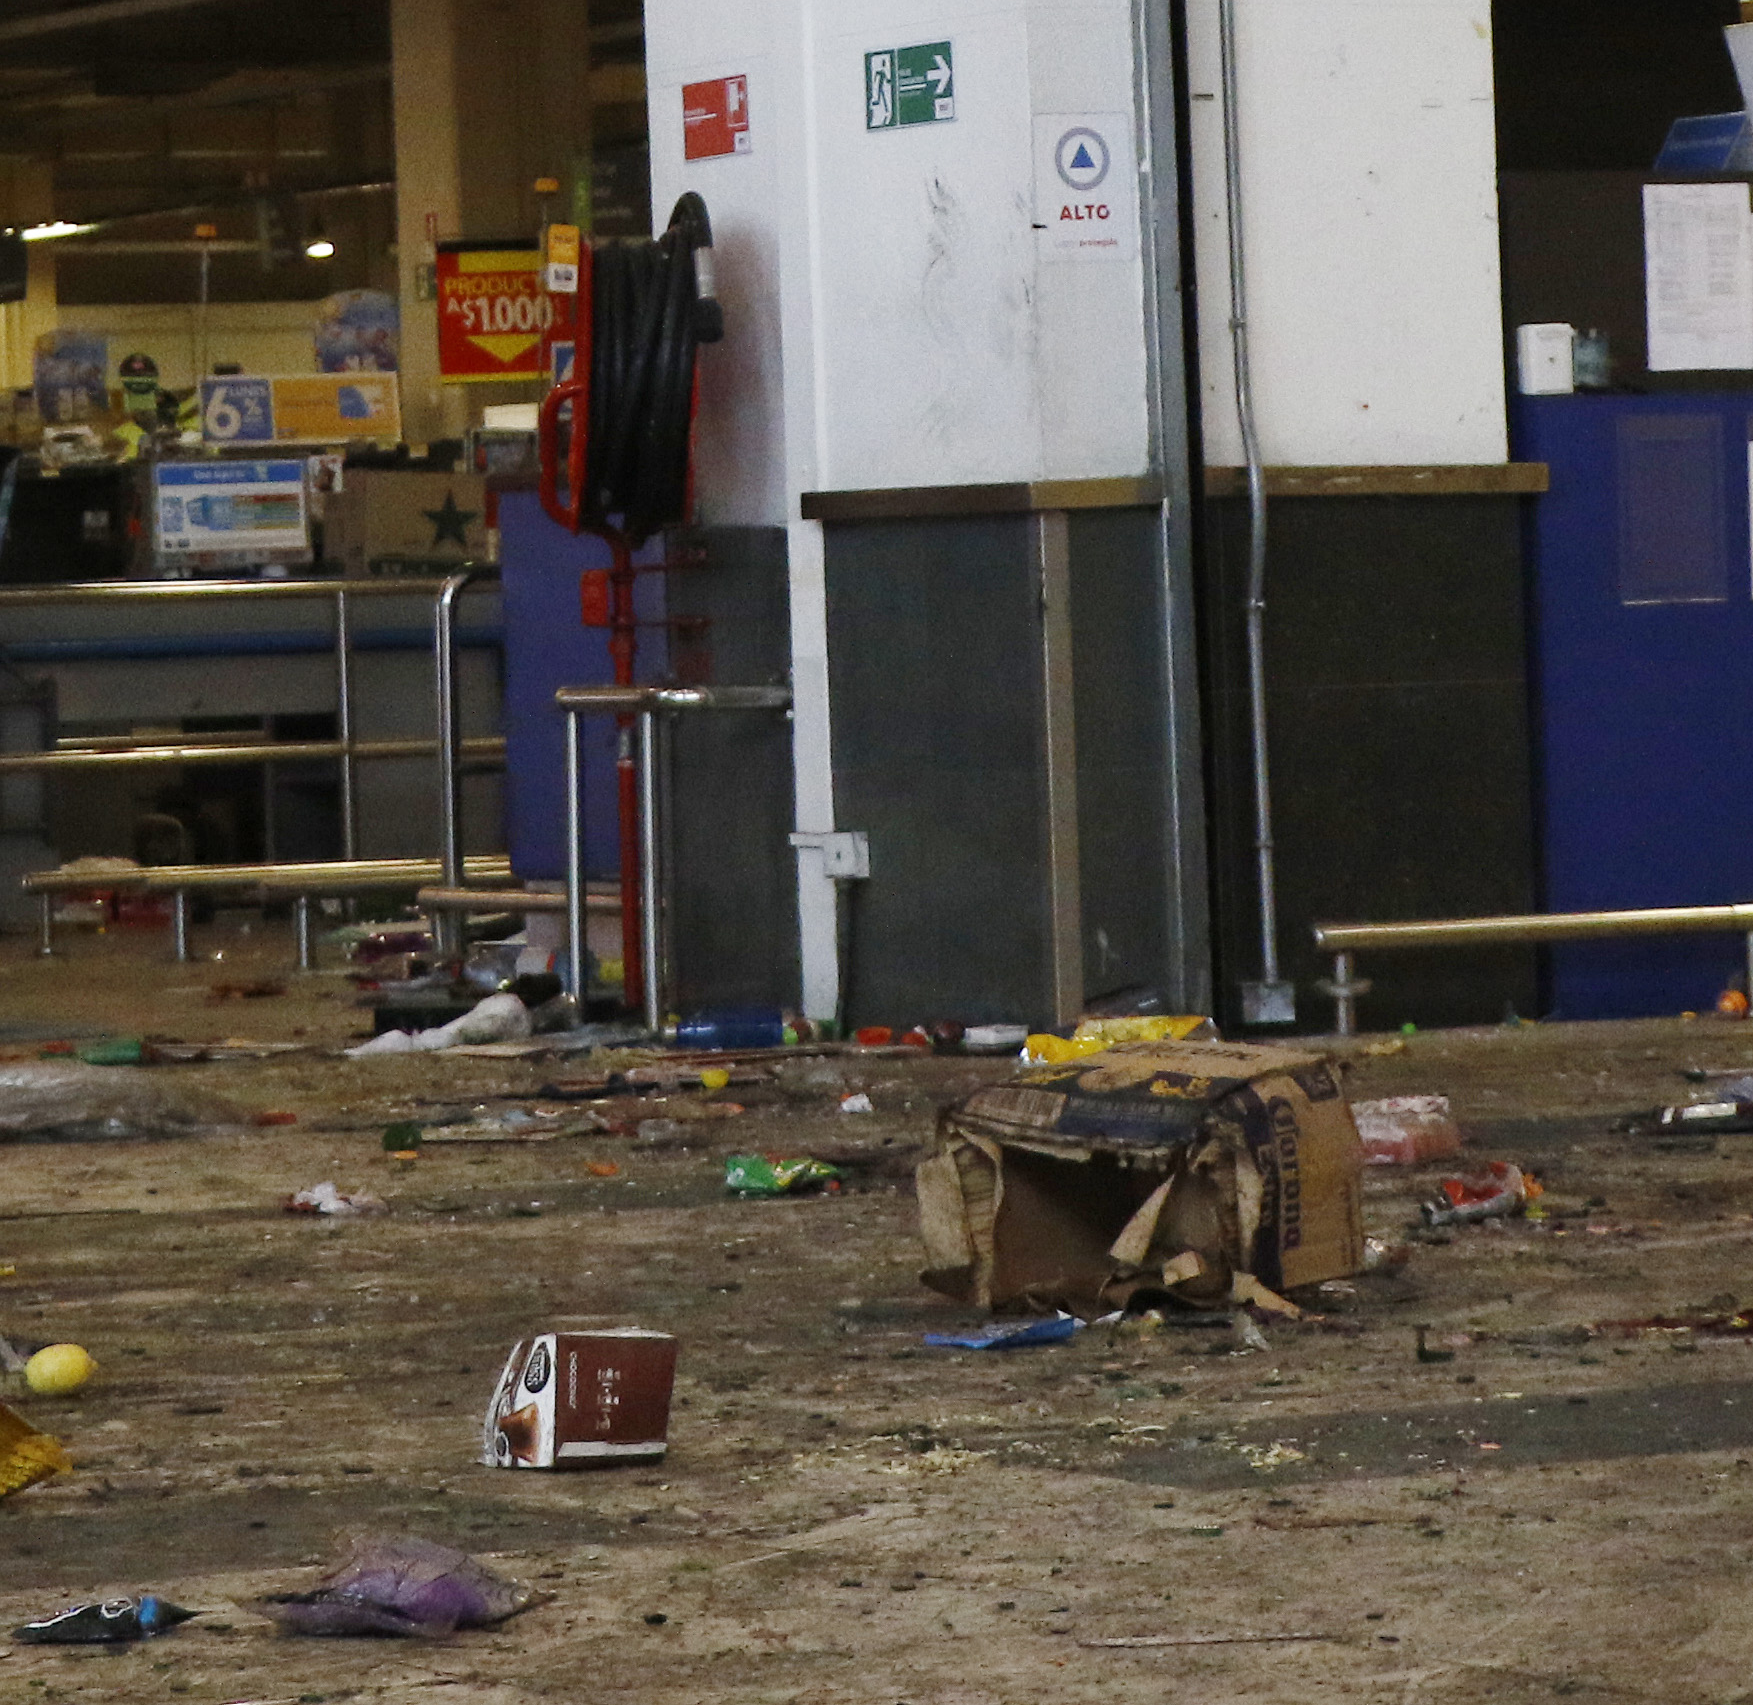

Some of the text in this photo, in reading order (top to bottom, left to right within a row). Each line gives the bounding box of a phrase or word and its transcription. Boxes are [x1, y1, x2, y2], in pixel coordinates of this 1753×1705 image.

[1060, 204, 1110, 221] ALTO
[206, 385, 243, 439] 6
[1268, 1096, 1301, 1251] Corona
